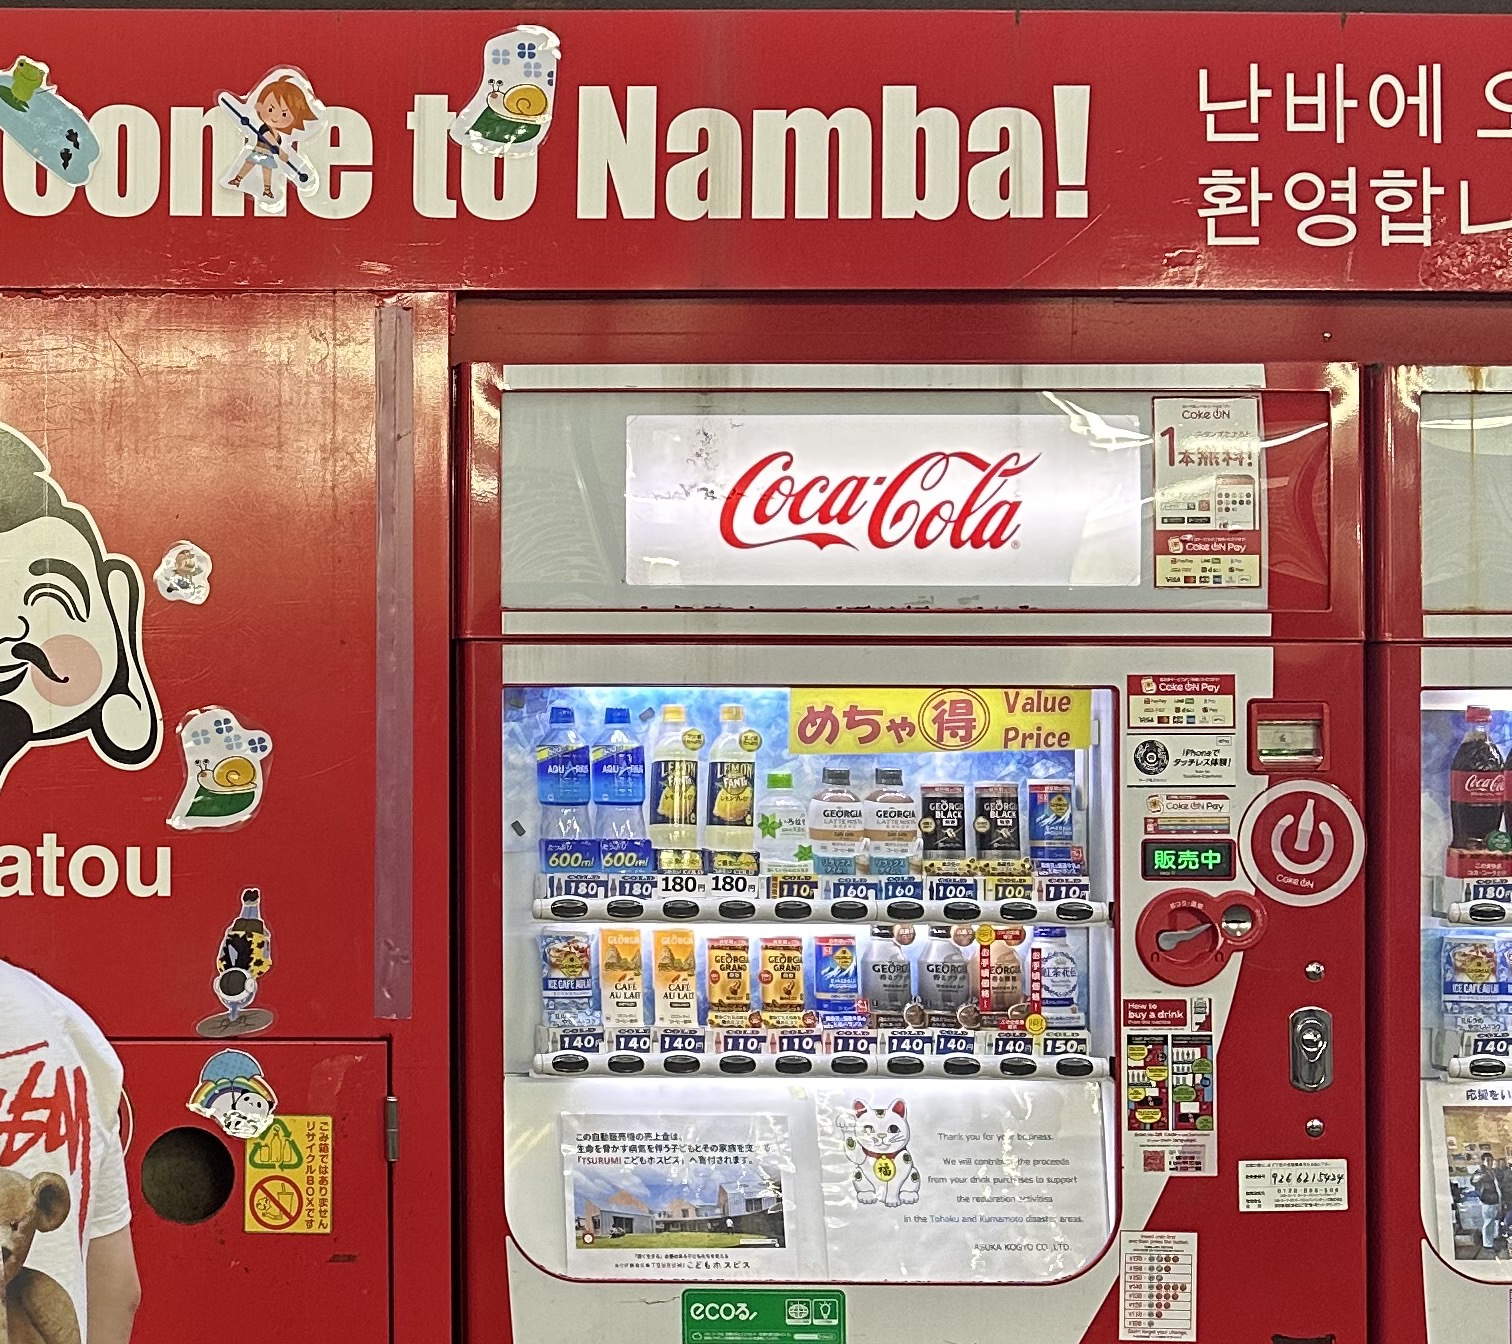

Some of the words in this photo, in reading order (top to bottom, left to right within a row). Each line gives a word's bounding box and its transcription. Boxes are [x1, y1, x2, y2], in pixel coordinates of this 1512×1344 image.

[1197, 62, 1442, 144] 난바에
[577, 85, 1090, 221] Namba!
[1181, 409, 1211, 420] Coke
[719, 449, 1044, 552] Coca-Cola
[1227, 542, 1247, 554] Pay
[1202, 683, 1221, 695] Pay
[1003, 689, 1072, 714] Value
[797, 699, 977, 745] めちゃ得
[1003, 726, 1071, 750] Price
[716, 761, 753, 778] LEMON
[822, 808, 862, 819] GEORGIA
[875, 809, 916, 819] GEORGIA
[935, 810, 963, 819] BLACK
[989, 810, 1017, 819] BLACK
[1205, 802, 1225, 814] Pay
[548, 852, 595, 868] 600ml
[602, 852, 649, 868] 600ml
[1153, 849, 1222, 871] 販売中
[569, 882, 598, 895] 180
[624, 883, 652, 895] 180
[660, 875, 707, 893] 180円
[711, 875, 757, 893] 180円
[609, 992, 622, 1000] AU
[663, 992, 676, 1000] AU
[1127, 1002, 1146, 1010] How
[1127, 1010, 1147, 1021] buy
[1149, 1012, 1157, 1020] a
[1158, 1009, 1184, 1020] drink
[616, 1036, 650, 1050] 140
[664, 1036, 704, 1050] 140円
[938, 1037, 975, 1050] 140円
[997, 1040, 1033, 1052] 140円
[1043, 1040, 1087, 1053] 150円
[1475, 1040, 1508, 1053] 140
[304, 1120, 317, 1230] リサイクルBOXです
[317, 1120, 330, 1230] ごみ箱ではありません
[877, 1162, 893, 1178] 福
[913, 1215, 928, 1223] the
[929, 1214, 960, 1224] Tohoku
[962, 1214, 977, 1223] and
[979, 1214, 1024, 1224] Kumamoto
